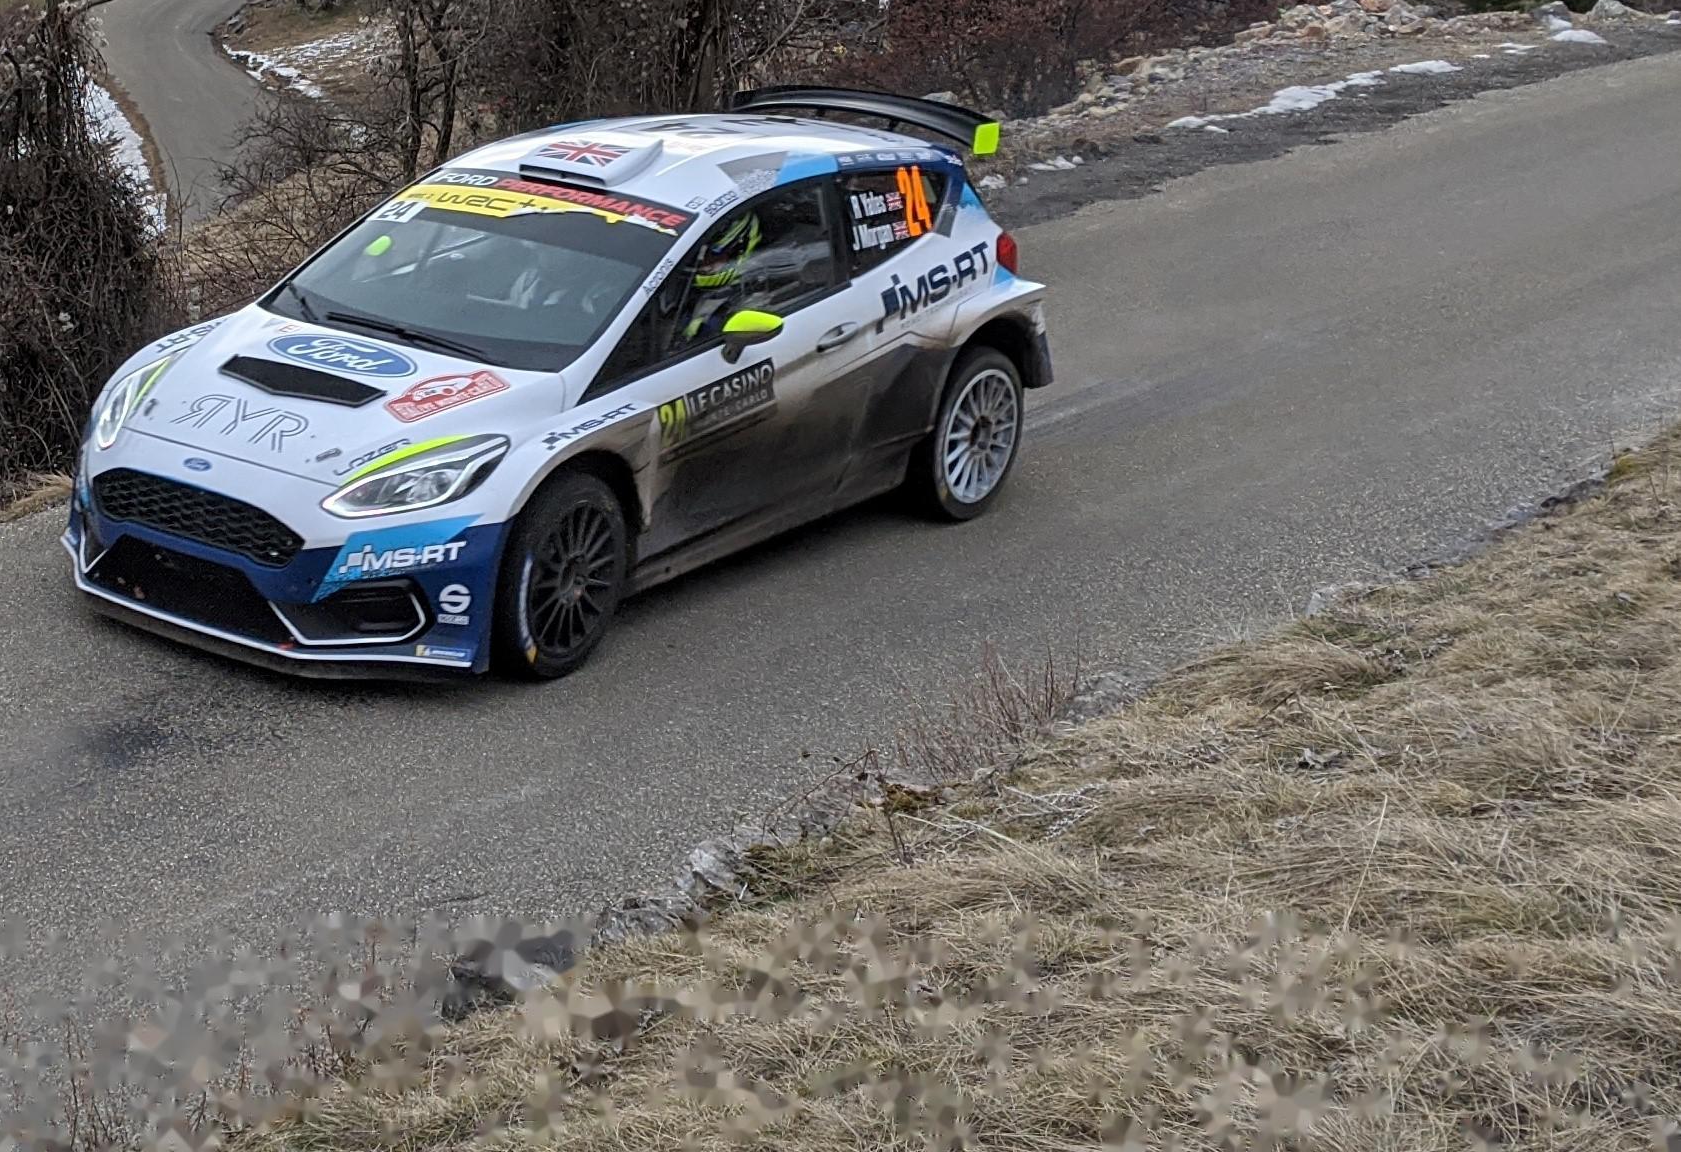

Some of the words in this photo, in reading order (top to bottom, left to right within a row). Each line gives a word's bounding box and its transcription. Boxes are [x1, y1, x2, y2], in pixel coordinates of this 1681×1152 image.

[378, 201, 415, 222] 24
[441, 172, 498, 187] FORD
[494, 178, 687, 228] PERFORMANCE
[897, 166, 932, 237] 24
[287, 338, 388, 371] Ford
[710, 364, 773, 406] CASINO
